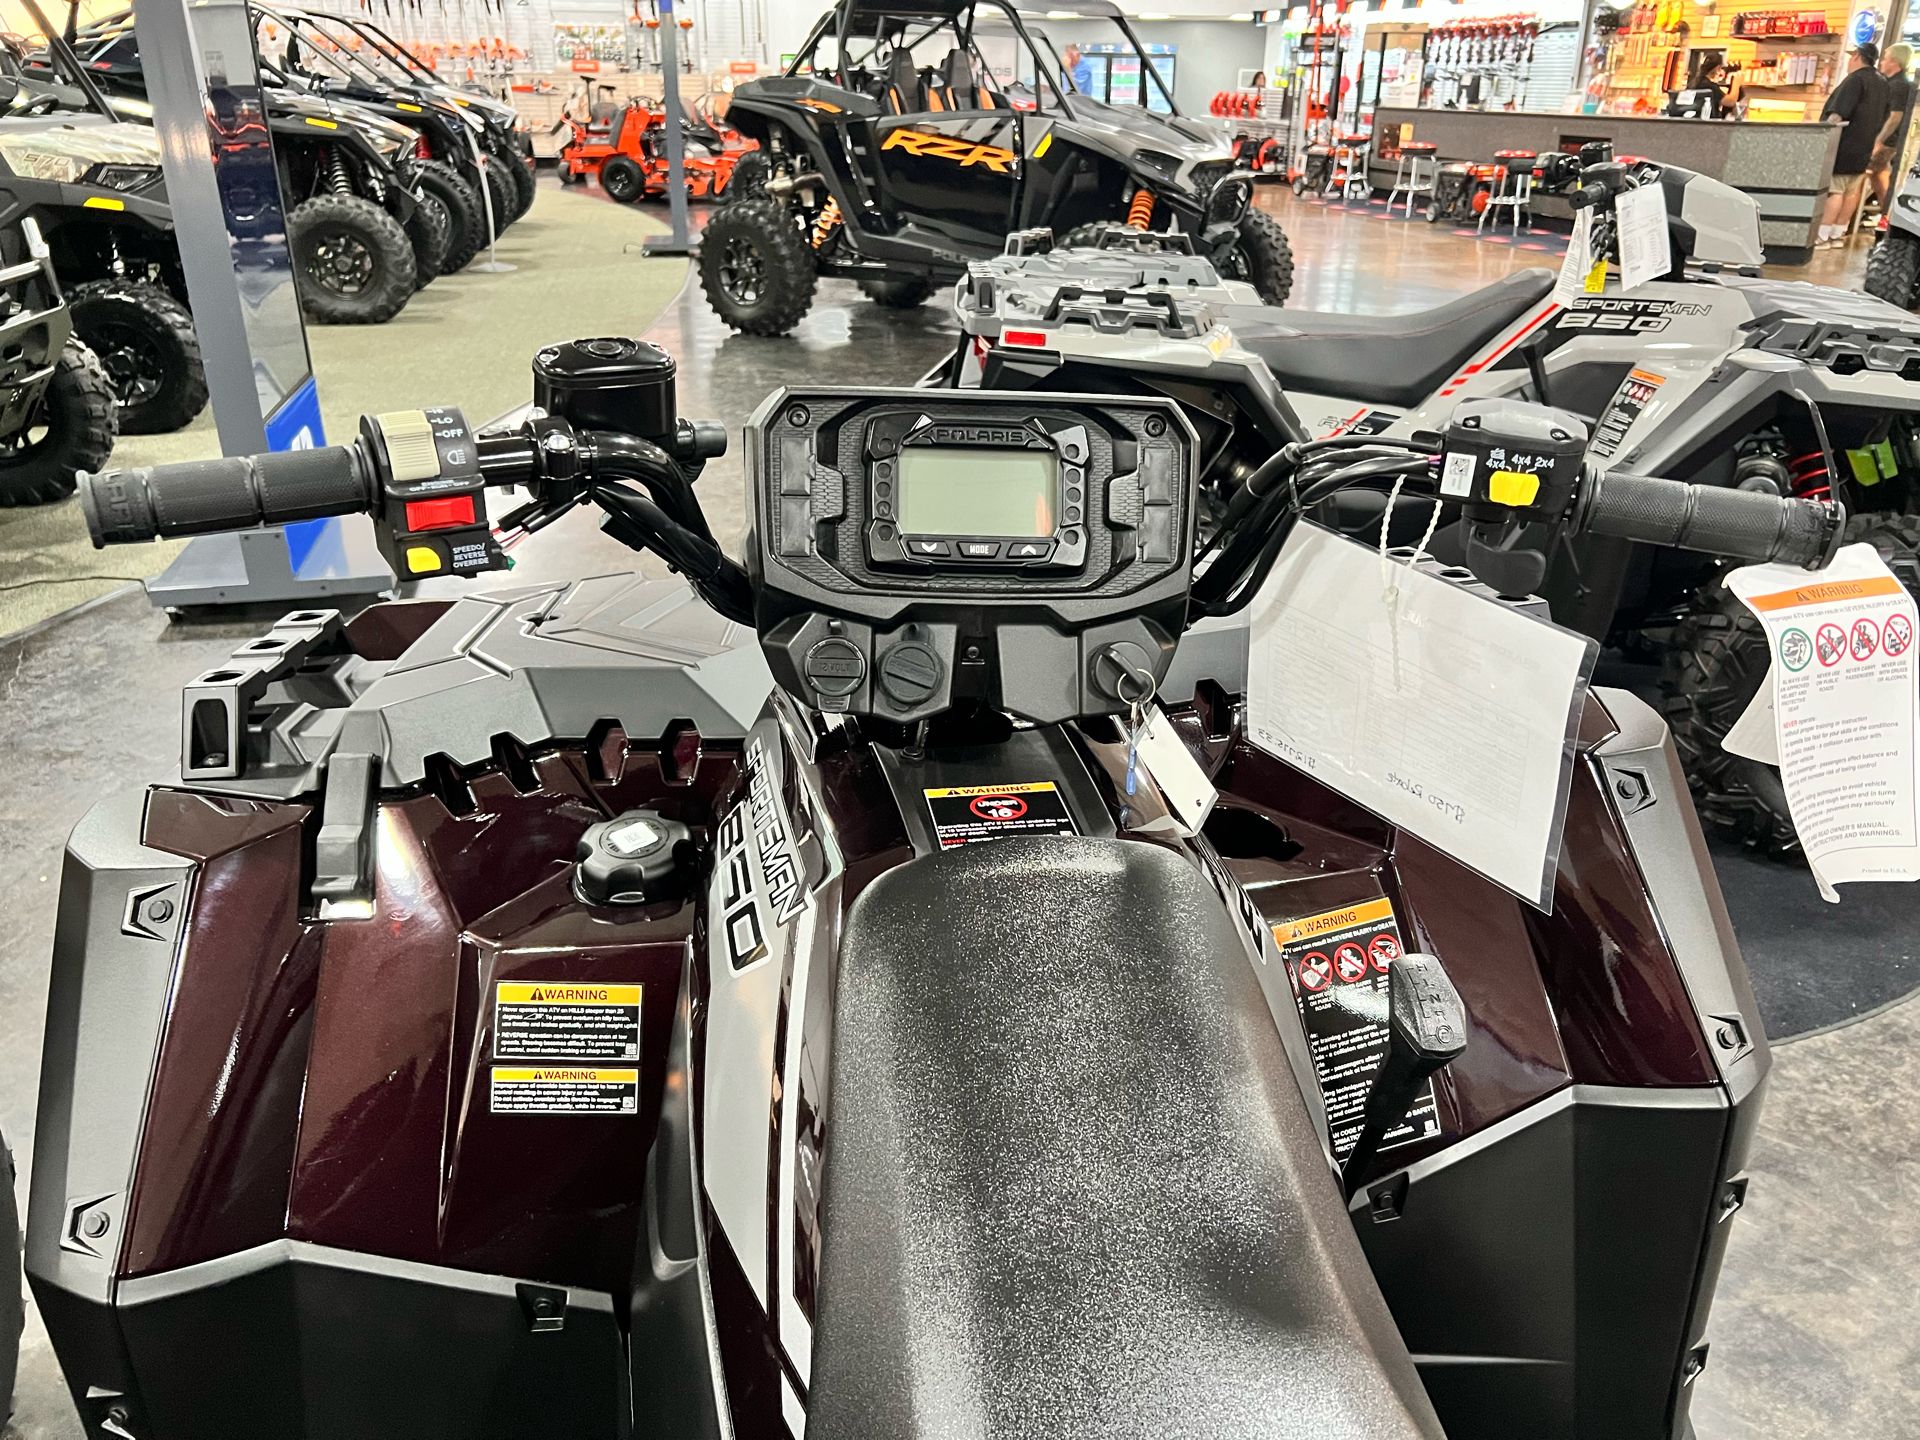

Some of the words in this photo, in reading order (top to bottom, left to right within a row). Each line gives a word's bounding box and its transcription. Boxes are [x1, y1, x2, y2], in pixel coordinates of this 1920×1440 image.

[881, 128, 1017, 173] RZR
[23, 150, 72, 167] 570
[1572, 299, 1712, 316] SPORTSMAN
[1555, 313, 1672, 333] 850
[935, 428, 1024, 442] POLARIS
[1485, 458, 1506, 469] 4x4
[1535, 456, 1555, 469] 2x4
[1511, 453, 1531, 466] 4x4
[453, 542, 485, 554] SPEEDO/
[969, 545, 990, 554] MODE
[454, 550, 487, 561] REVERSE
[453, 557, 489, 569] OVERRIDE
[1810, 584, 1863, 600] WARNING
[1868, 721, 1898, 730] conditions
[1857, 762, 1877, 770] control
[962, 785, 1031, 795] WARNING
[977, 800, 1019, 808] UNDER
[988, 808, 1013, 818] 16
[1856, 821, 1889, 829] MANUAL.
[745, 736, 809, 929] SPORTSMAN
[1858, 829, 1903, 837] WARNINGS.
[717, 800, 773, 978] 850
[1304, 911, 1357, 933] WARNING
[544, 990, 608, 1000] WARNING
[544, 1071, 597, 1080] WARNING
[1340, 1126, 1357, 1136] CODE
